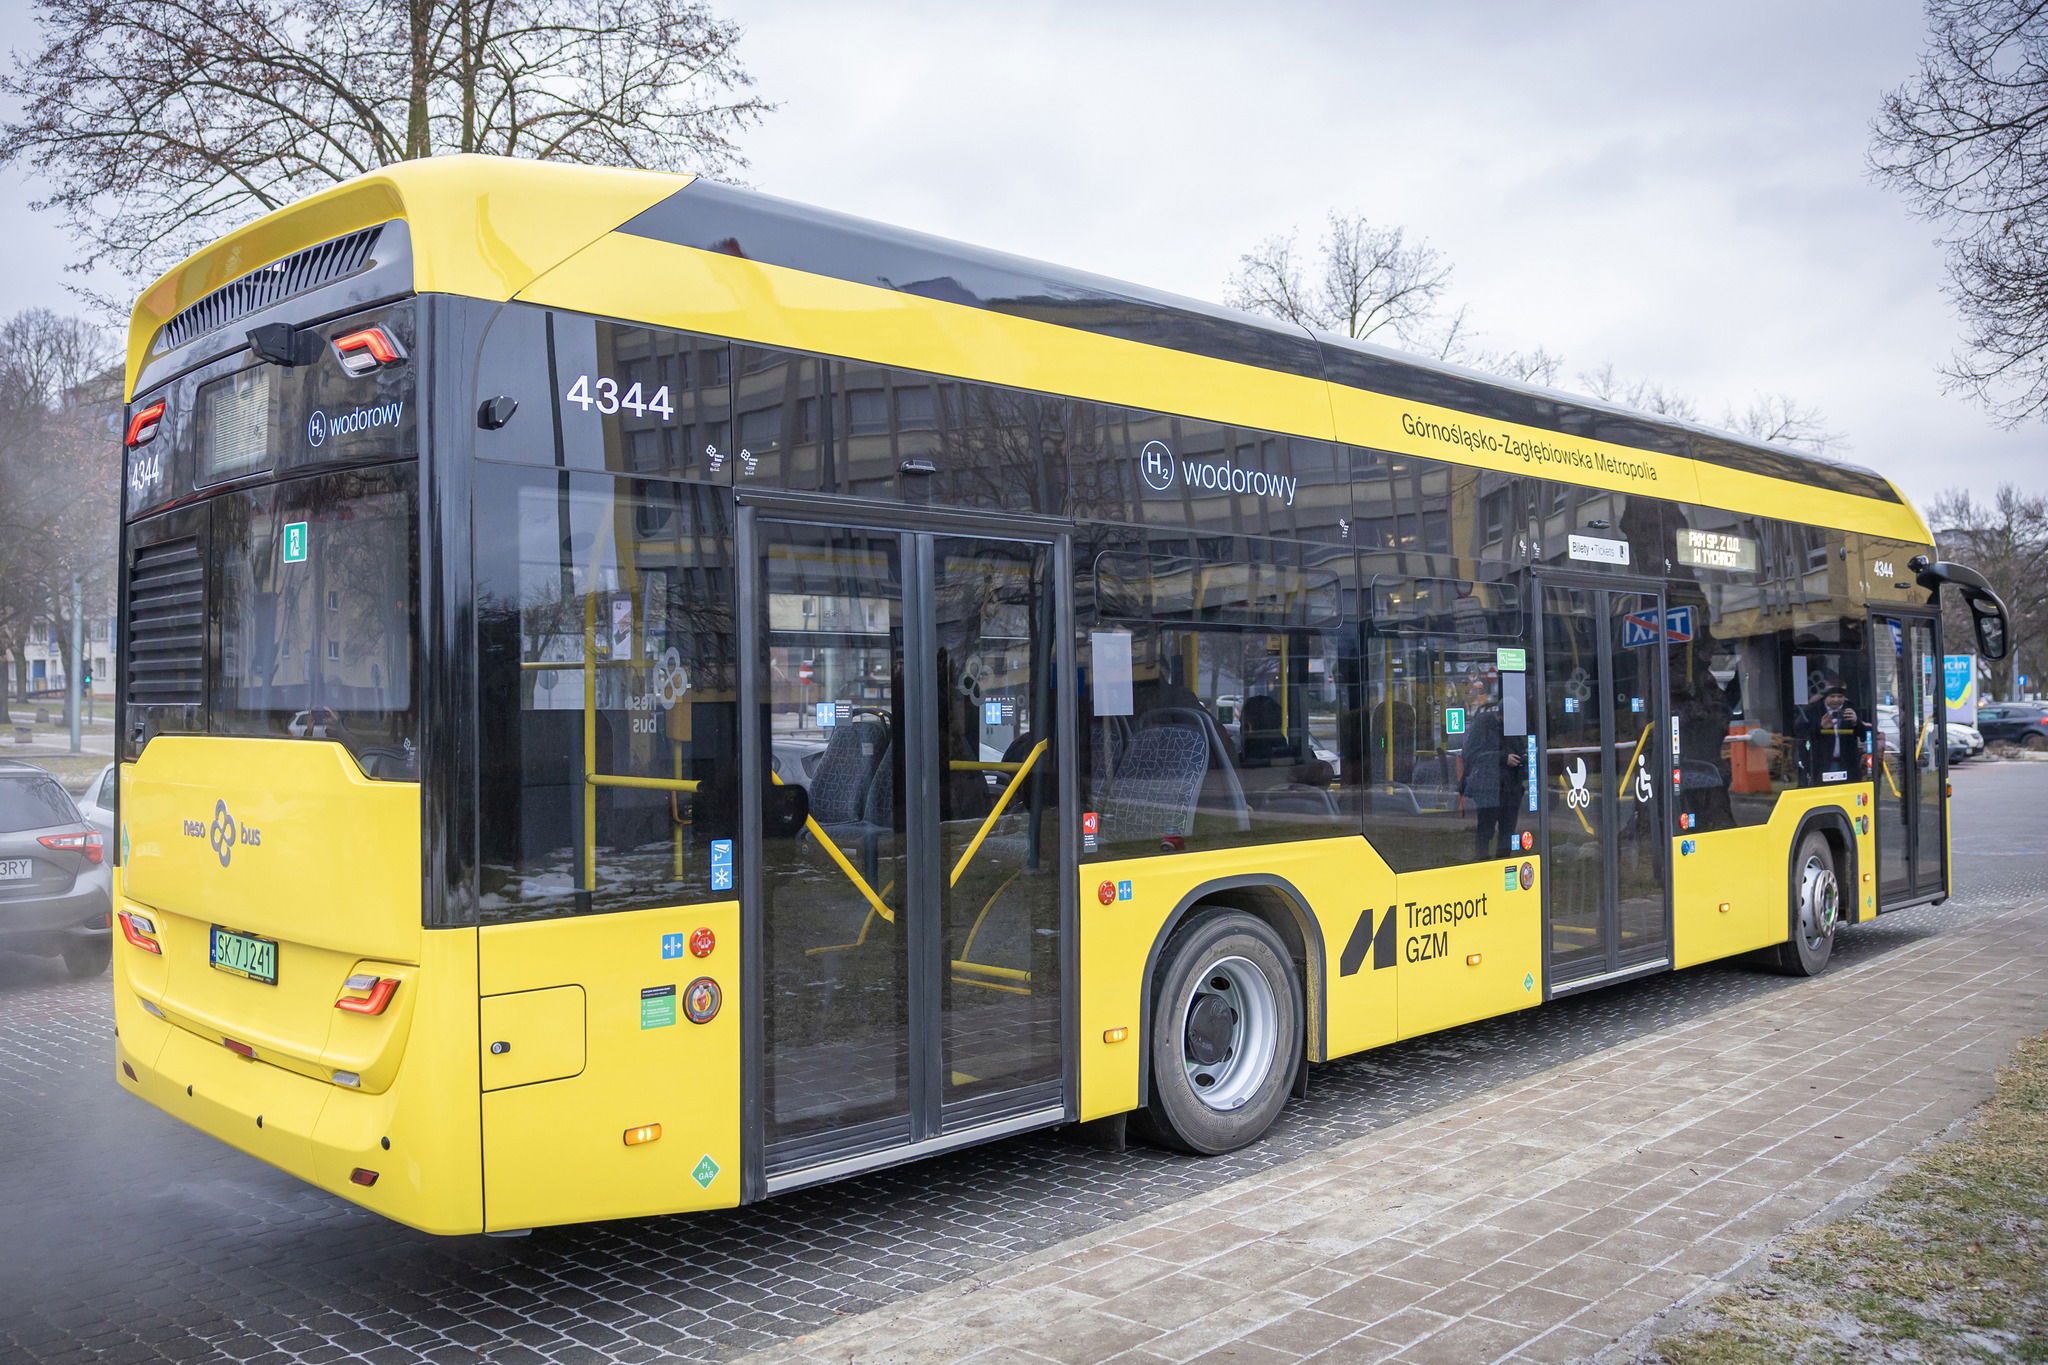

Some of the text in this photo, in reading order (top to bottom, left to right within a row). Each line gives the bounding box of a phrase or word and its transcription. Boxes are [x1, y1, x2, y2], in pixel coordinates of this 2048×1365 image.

[566, 375, 674, 420] 4344
[330, 401, 404, 437] wodorowy
[1402, 413, 1657, 481] Górnośląsko-Zagłębiowska Metropolia
[132, 454, 159, 491] 4344
[1182, 460, 1297, 506] wodorowy
[1572, 541, 1590, 556] Bilety
[1689, 531, 1705, 548] PKM
[1874, 560, 1894, 578] 4344
[183, 819, 261, 846] neso bus
[1405, 893, 1487, 928] Transport
[218, 934, 232, 964] SK
[235, 938, 270, 975] 7J241
[1406, 931, 1448, 963] GZM
[698, 1170, 714, 1181] GAS
